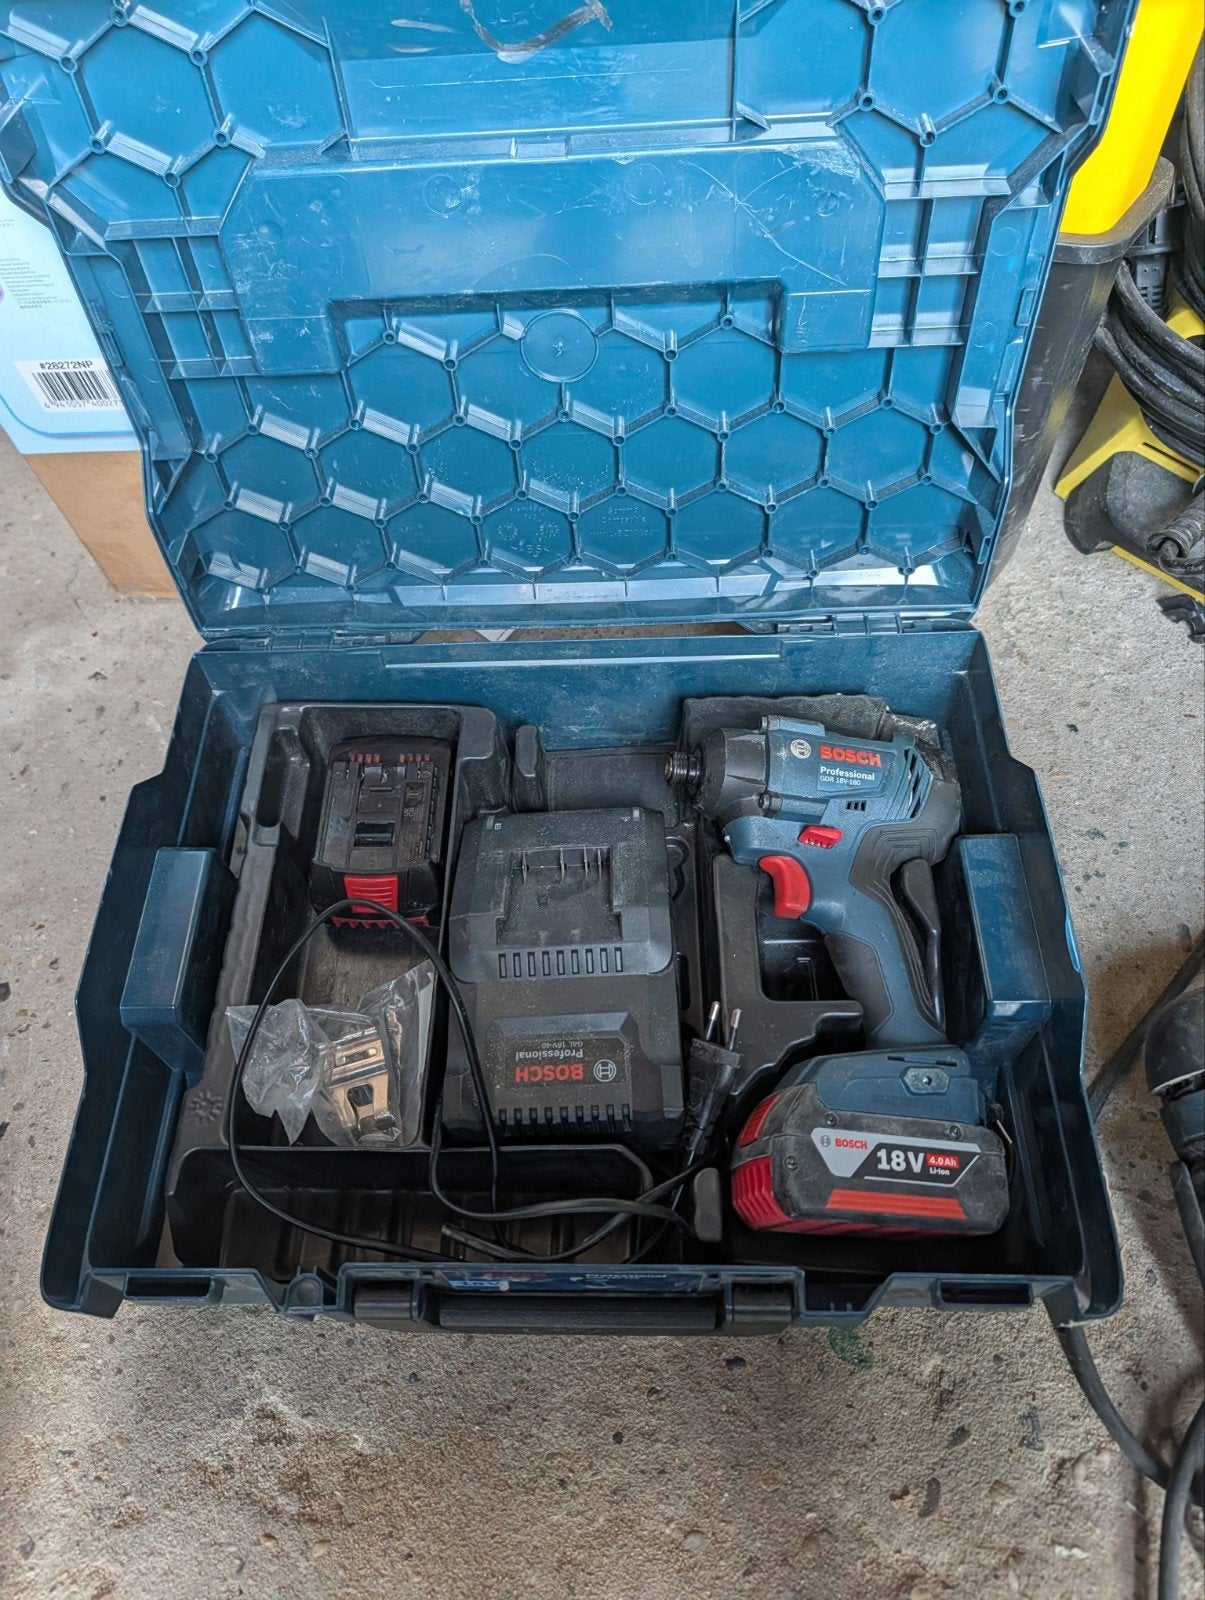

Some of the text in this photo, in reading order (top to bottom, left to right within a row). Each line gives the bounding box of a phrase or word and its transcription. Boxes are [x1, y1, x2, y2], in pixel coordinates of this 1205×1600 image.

[40, 361, 93, 370] #28272NP
[820, 745, 881, 768] BOSCH
[820, 766, 875, 781] Professional
[820, 775, 834, 783] GDR
[569, 1040, 584, 1048] GAL
[515, 1049, 584, 1061] Professional
[515, 1064, 584, 1082] BOSCH
[835, 1138, 868, 1149] BOSCH
[876, 1148, 925, 1174] 18V
[930, 1167, 950, 1175] Li-Ion
